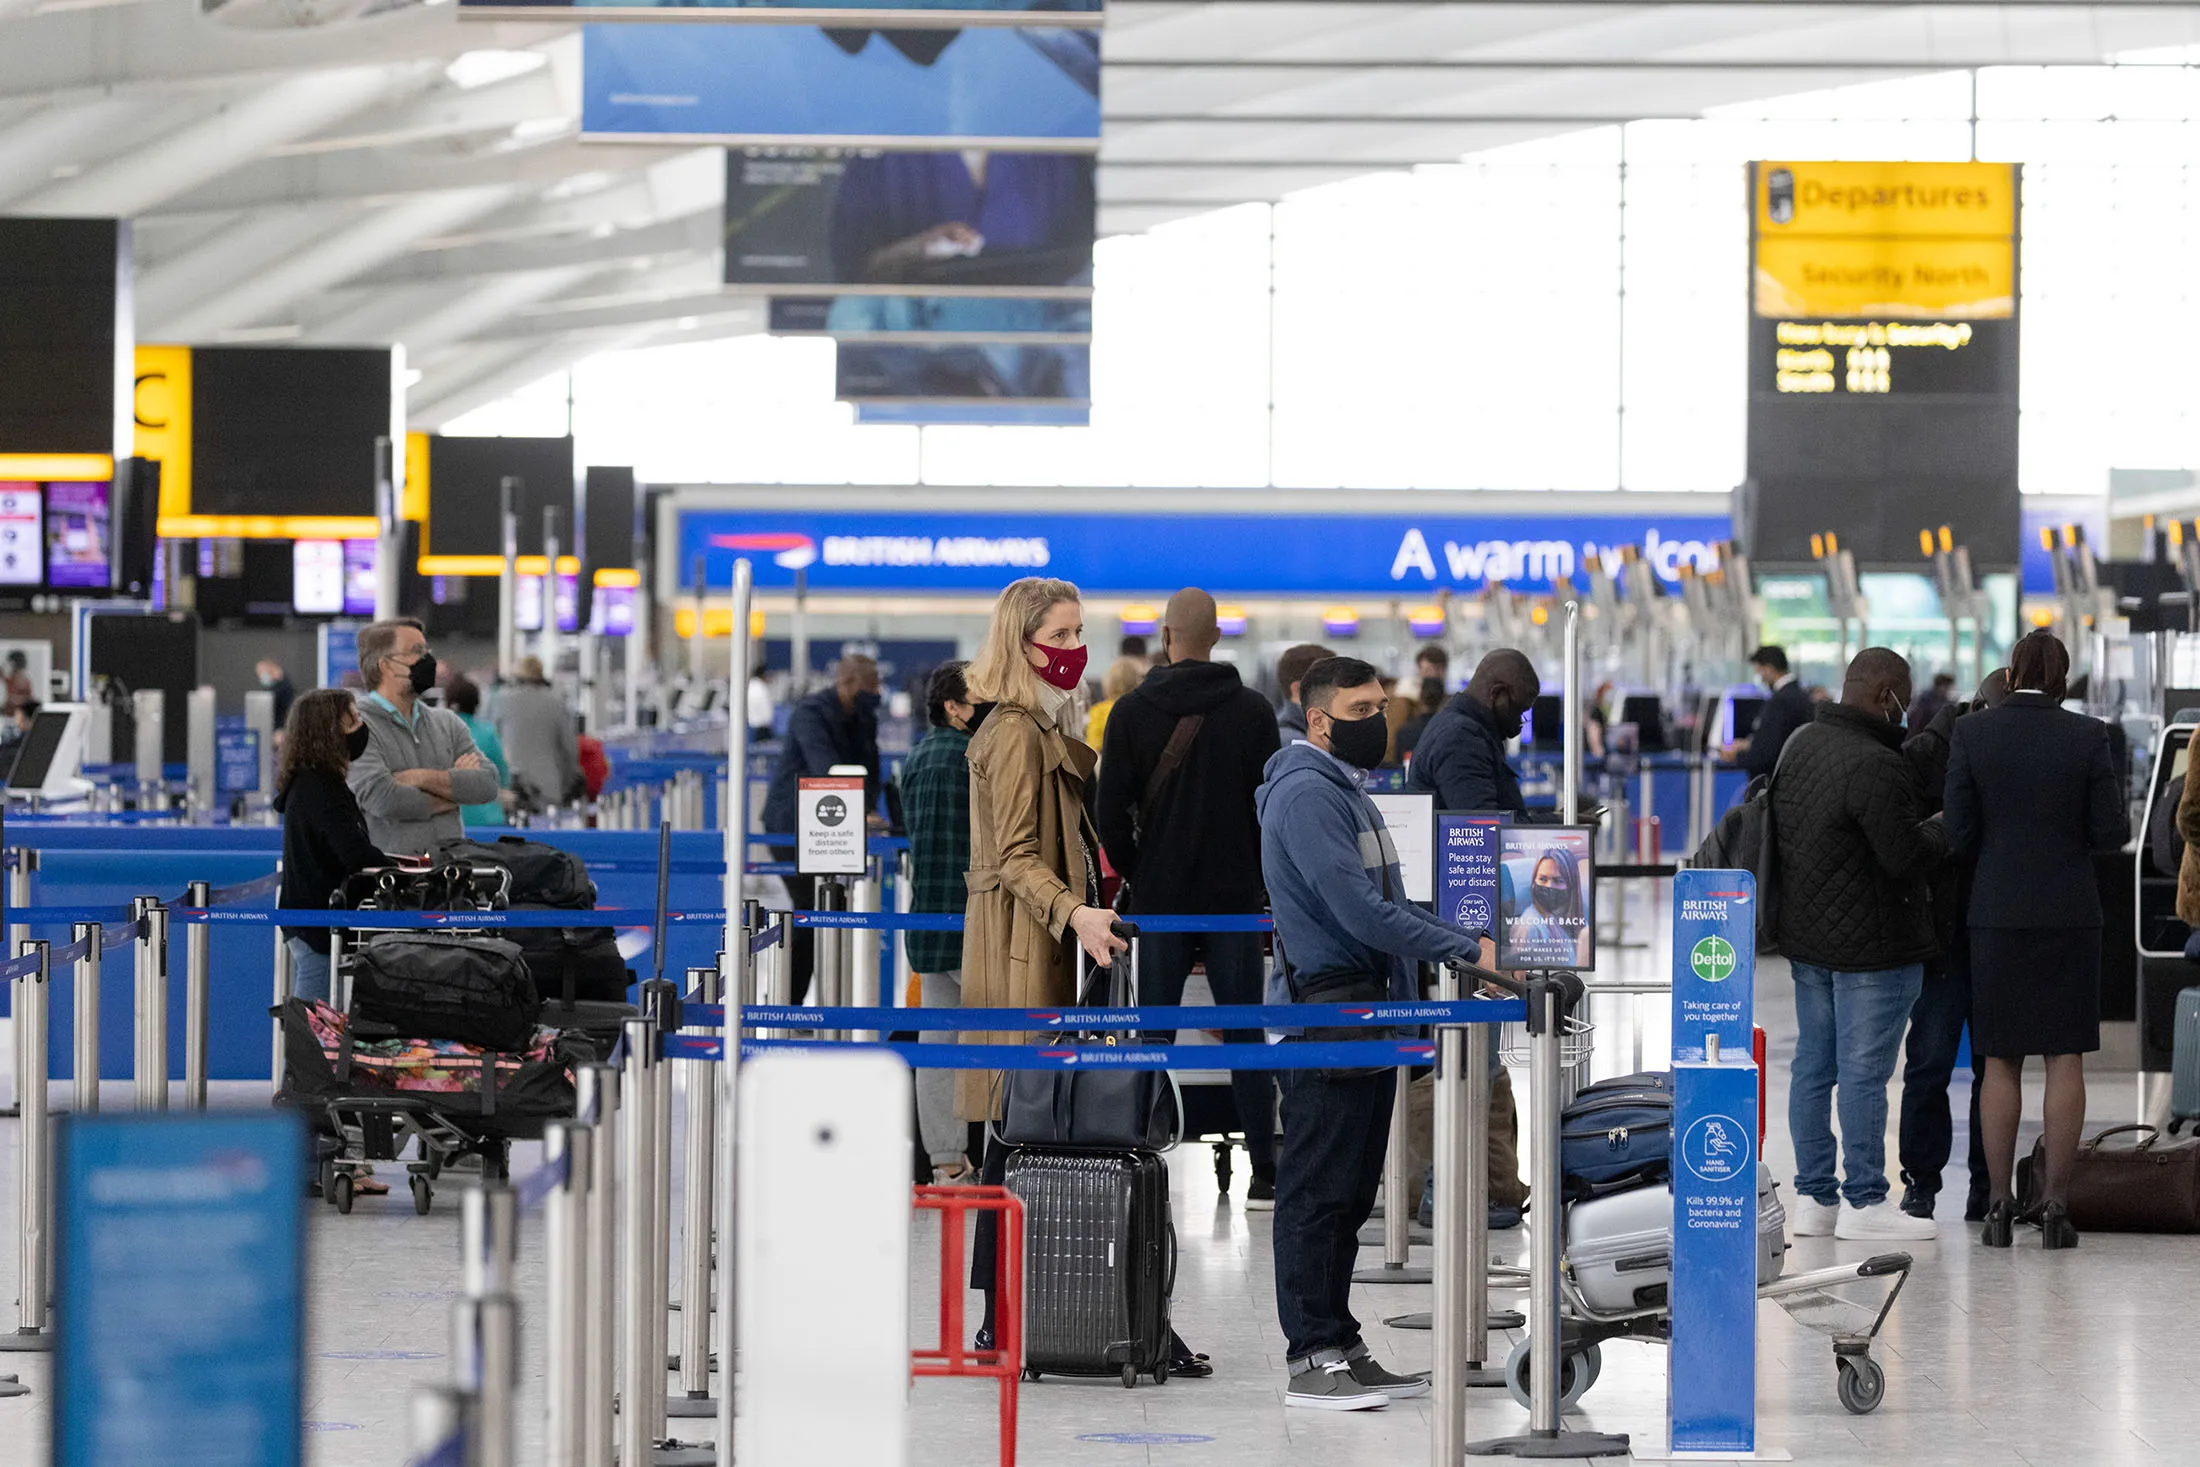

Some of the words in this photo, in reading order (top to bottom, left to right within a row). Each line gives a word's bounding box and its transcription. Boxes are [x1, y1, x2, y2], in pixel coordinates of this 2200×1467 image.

[1803, 180, 1990, 213] Departures
[1802, 264, 1904, 289] Security
[1913, 264, 1990, 284] North
[134, 373, 166, 429] C
[823, 535, 933, 567] BRITISH
[934, 536, 1050, 567] AIRWAYS
[1391, 527, 1437, 580] A
[1444, 540, 1575, 581] warm
[809, 830, 829, 838] Keep
[1449, 828, 1484, 837] BRITISH
[1447, 838, 1485, 846] AIRWAYS
[1505, 842, 1536, 850] BRITISH
[1449, 853, 1474, 862] Please
[1476, 854, 1492, 864] stay
[1448, 865, 1464, 875] safe
[1466, 866, 1481, 875] and
[1482, 865, 1496, 875] kee
[1448, 880, 1467, 888] your
[1468, 878, 1496, 887] distanc
[1683, 900, 1727, 910] BRITISH
[810, 915, 837, 923] BRITISH
[838, 916, 868, 924] AIRWAYS
[1680, 911, 1728, 920] AIRWAYS
[1505, 917, 1555, 926] WELCOME
[1558, 917, 1585, 926] BACK
[1694, 952, 1732, 965] Dettol
[1682, 1001, 1710, 1012] Taking
[1712, 1002, 1730, 1010] care
[1732, 1001, 1741, 1010] of
[747, 1011, 784, 1021] BRITISH
[785, 1012, 824, 1022] AIRWAYS
[1377, 1009, 1412, 1018] BRITISH
[1413, 1008, 1451, 1017] AIRWAYS
[1684, 1014, 1700, 1023] you
[1702, 1013, 1739, 1022] together
[1064, 1014, 1100, 1023] BRITISH
[1102, 1014, 1141, 1023] AIRWAYS
[1081, 1052, 1122, 1063] BRITISH
[1124, 1052, 1168, 1063] AIRWAYS
[1686, 1197, 1704, 1206] Kills
[1706, 1197, 1733, 1206] 99.9%
[1734, 1197, 1744, 1206] of
[1689, 1208, 1723, 1217] bacteria
[1725, 1208, 1741, 1217] and
